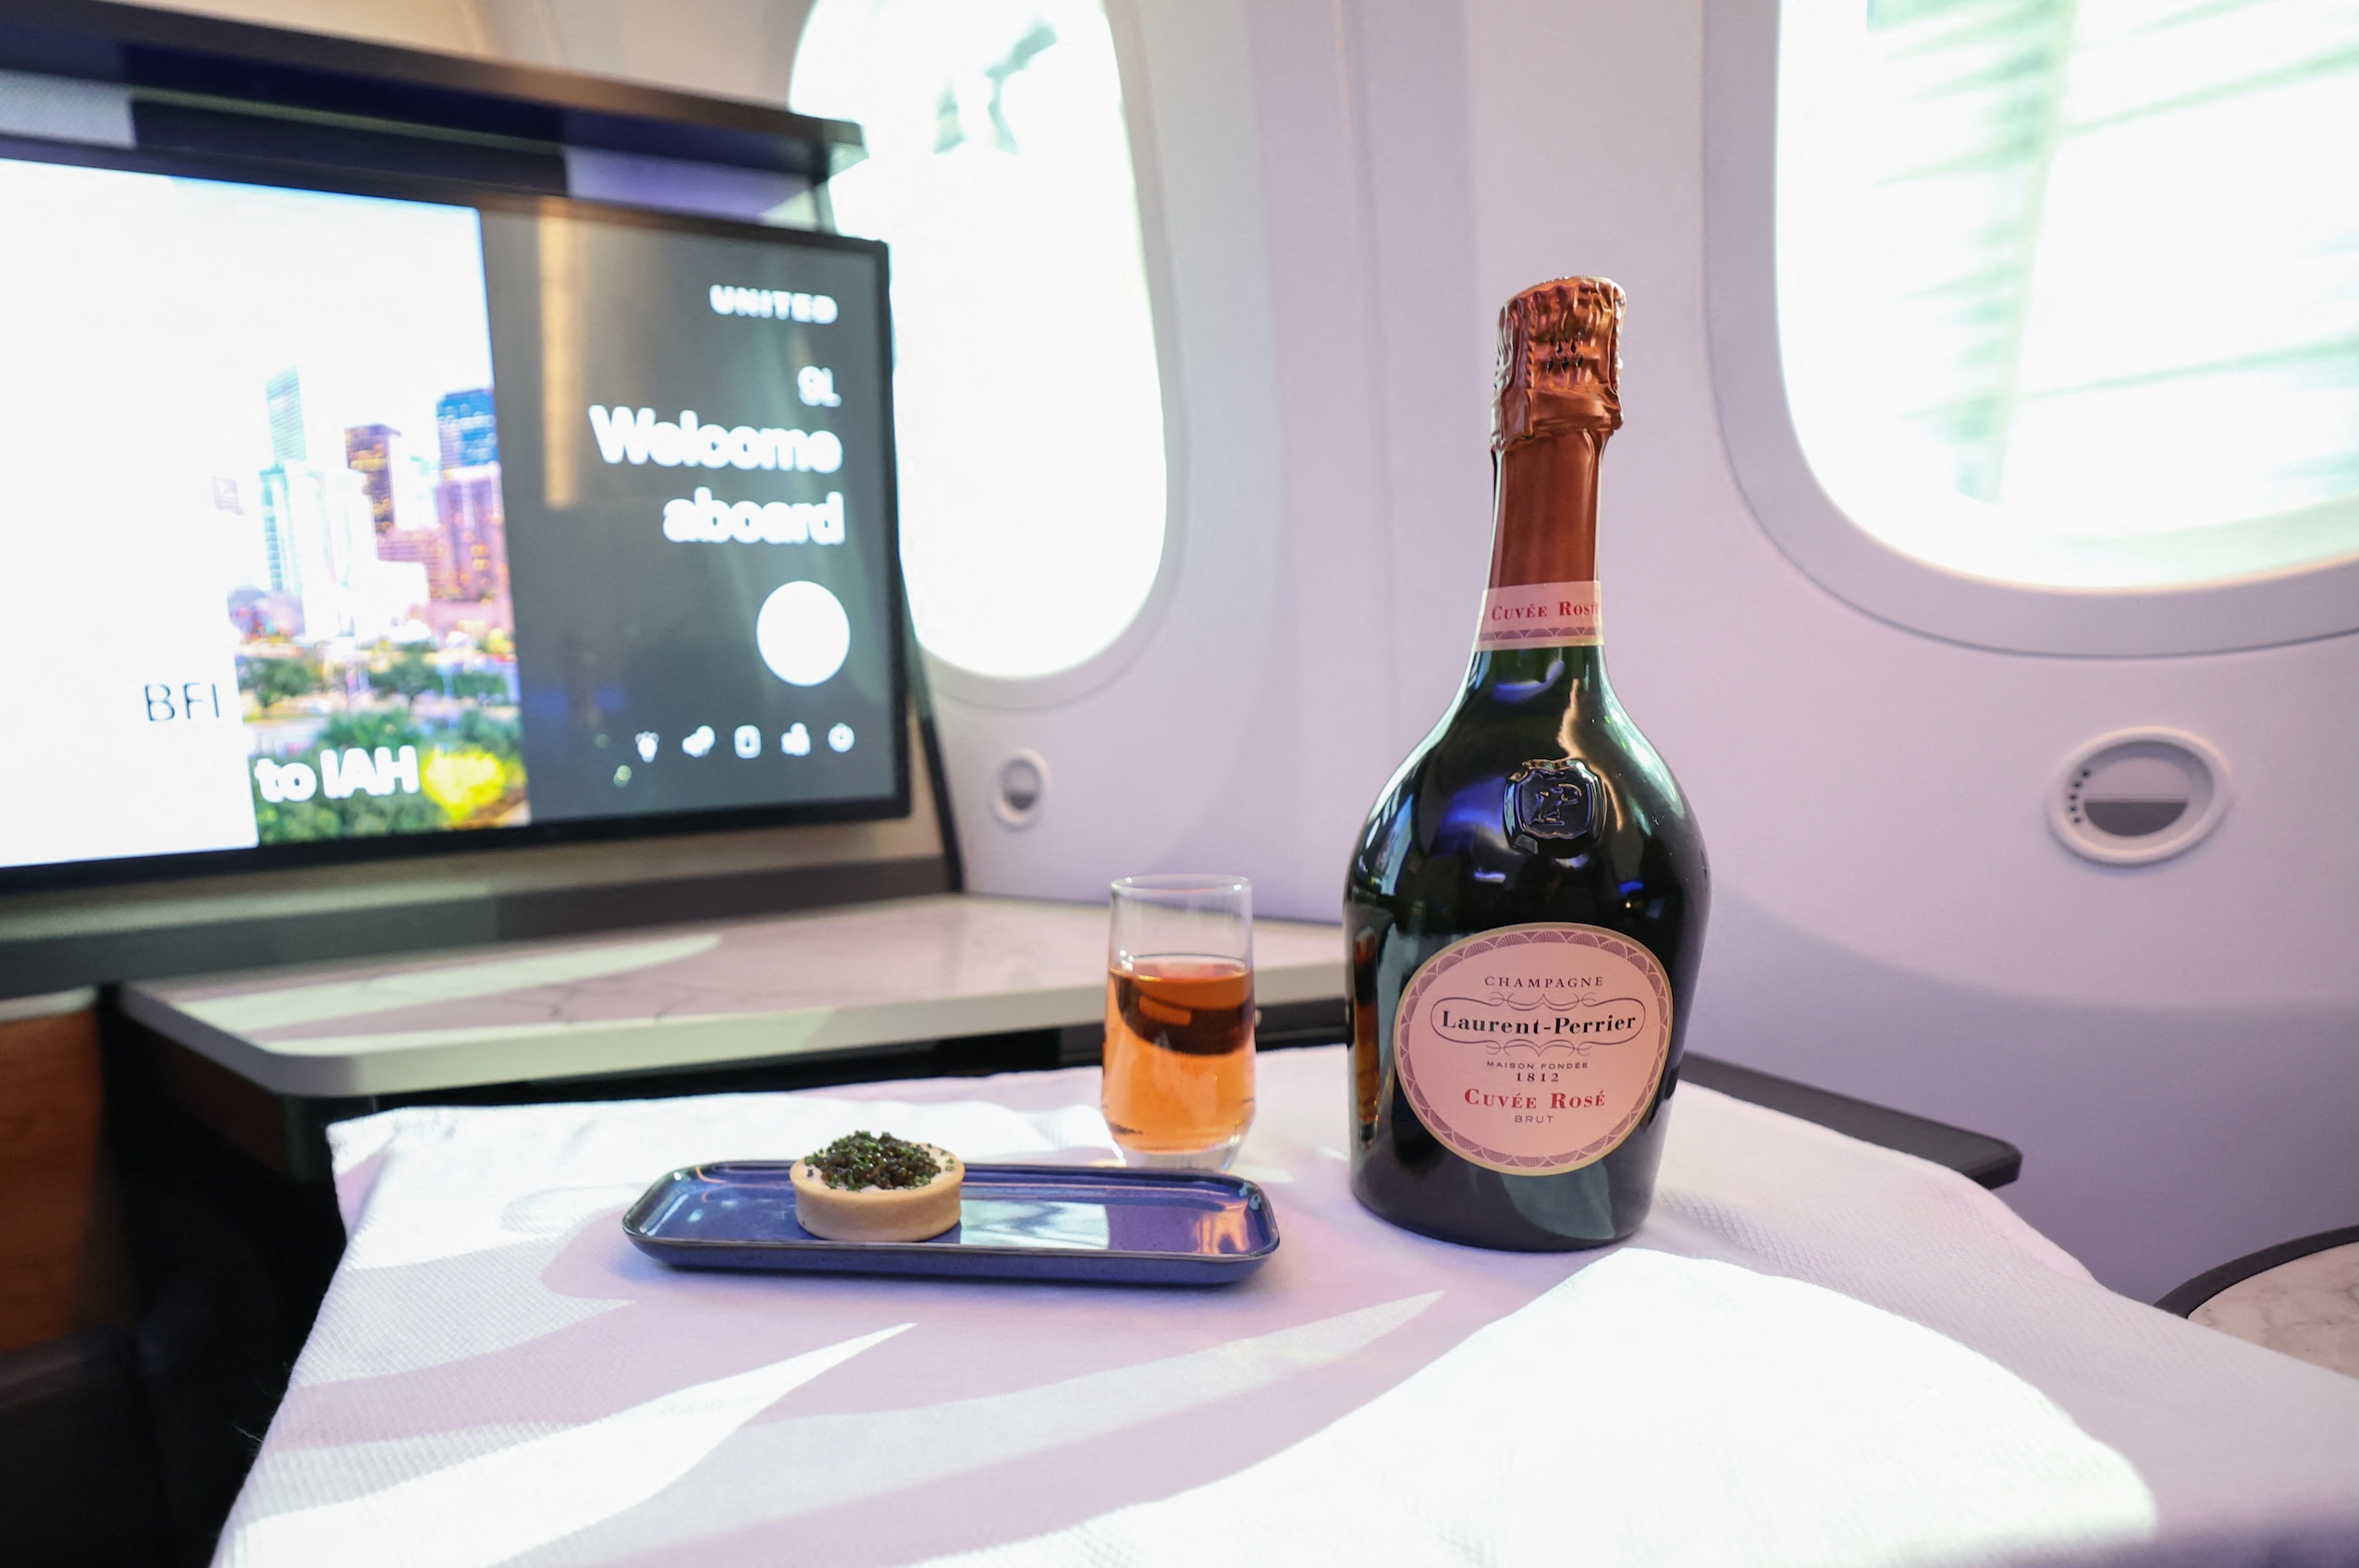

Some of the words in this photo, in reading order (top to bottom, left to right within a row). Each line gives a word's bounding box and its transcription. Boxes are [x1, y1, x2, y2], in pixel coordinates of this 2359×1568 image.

[709, 285, 838, 324] UNITED
[588, 405, 842, 473] Welcome
[663, 487, 845, 545] aboard
[144, 683, 220, 722] BFI
[254, 758, 317, 802] to
[320, 745, 420, 799] IAH
[1484, 976, 1603, 988] CHAMPAGNE
[1443, 1011, 1636, 1035] Laurent-Perrier
[1486, 1060, 1534, 1070] MAISON
[1541, 1061, 1589, 1070] FONDÉE
[1516, 1072, 1560, 1083] 1812
[1514, 1115, 1554, 1124] BRUT
